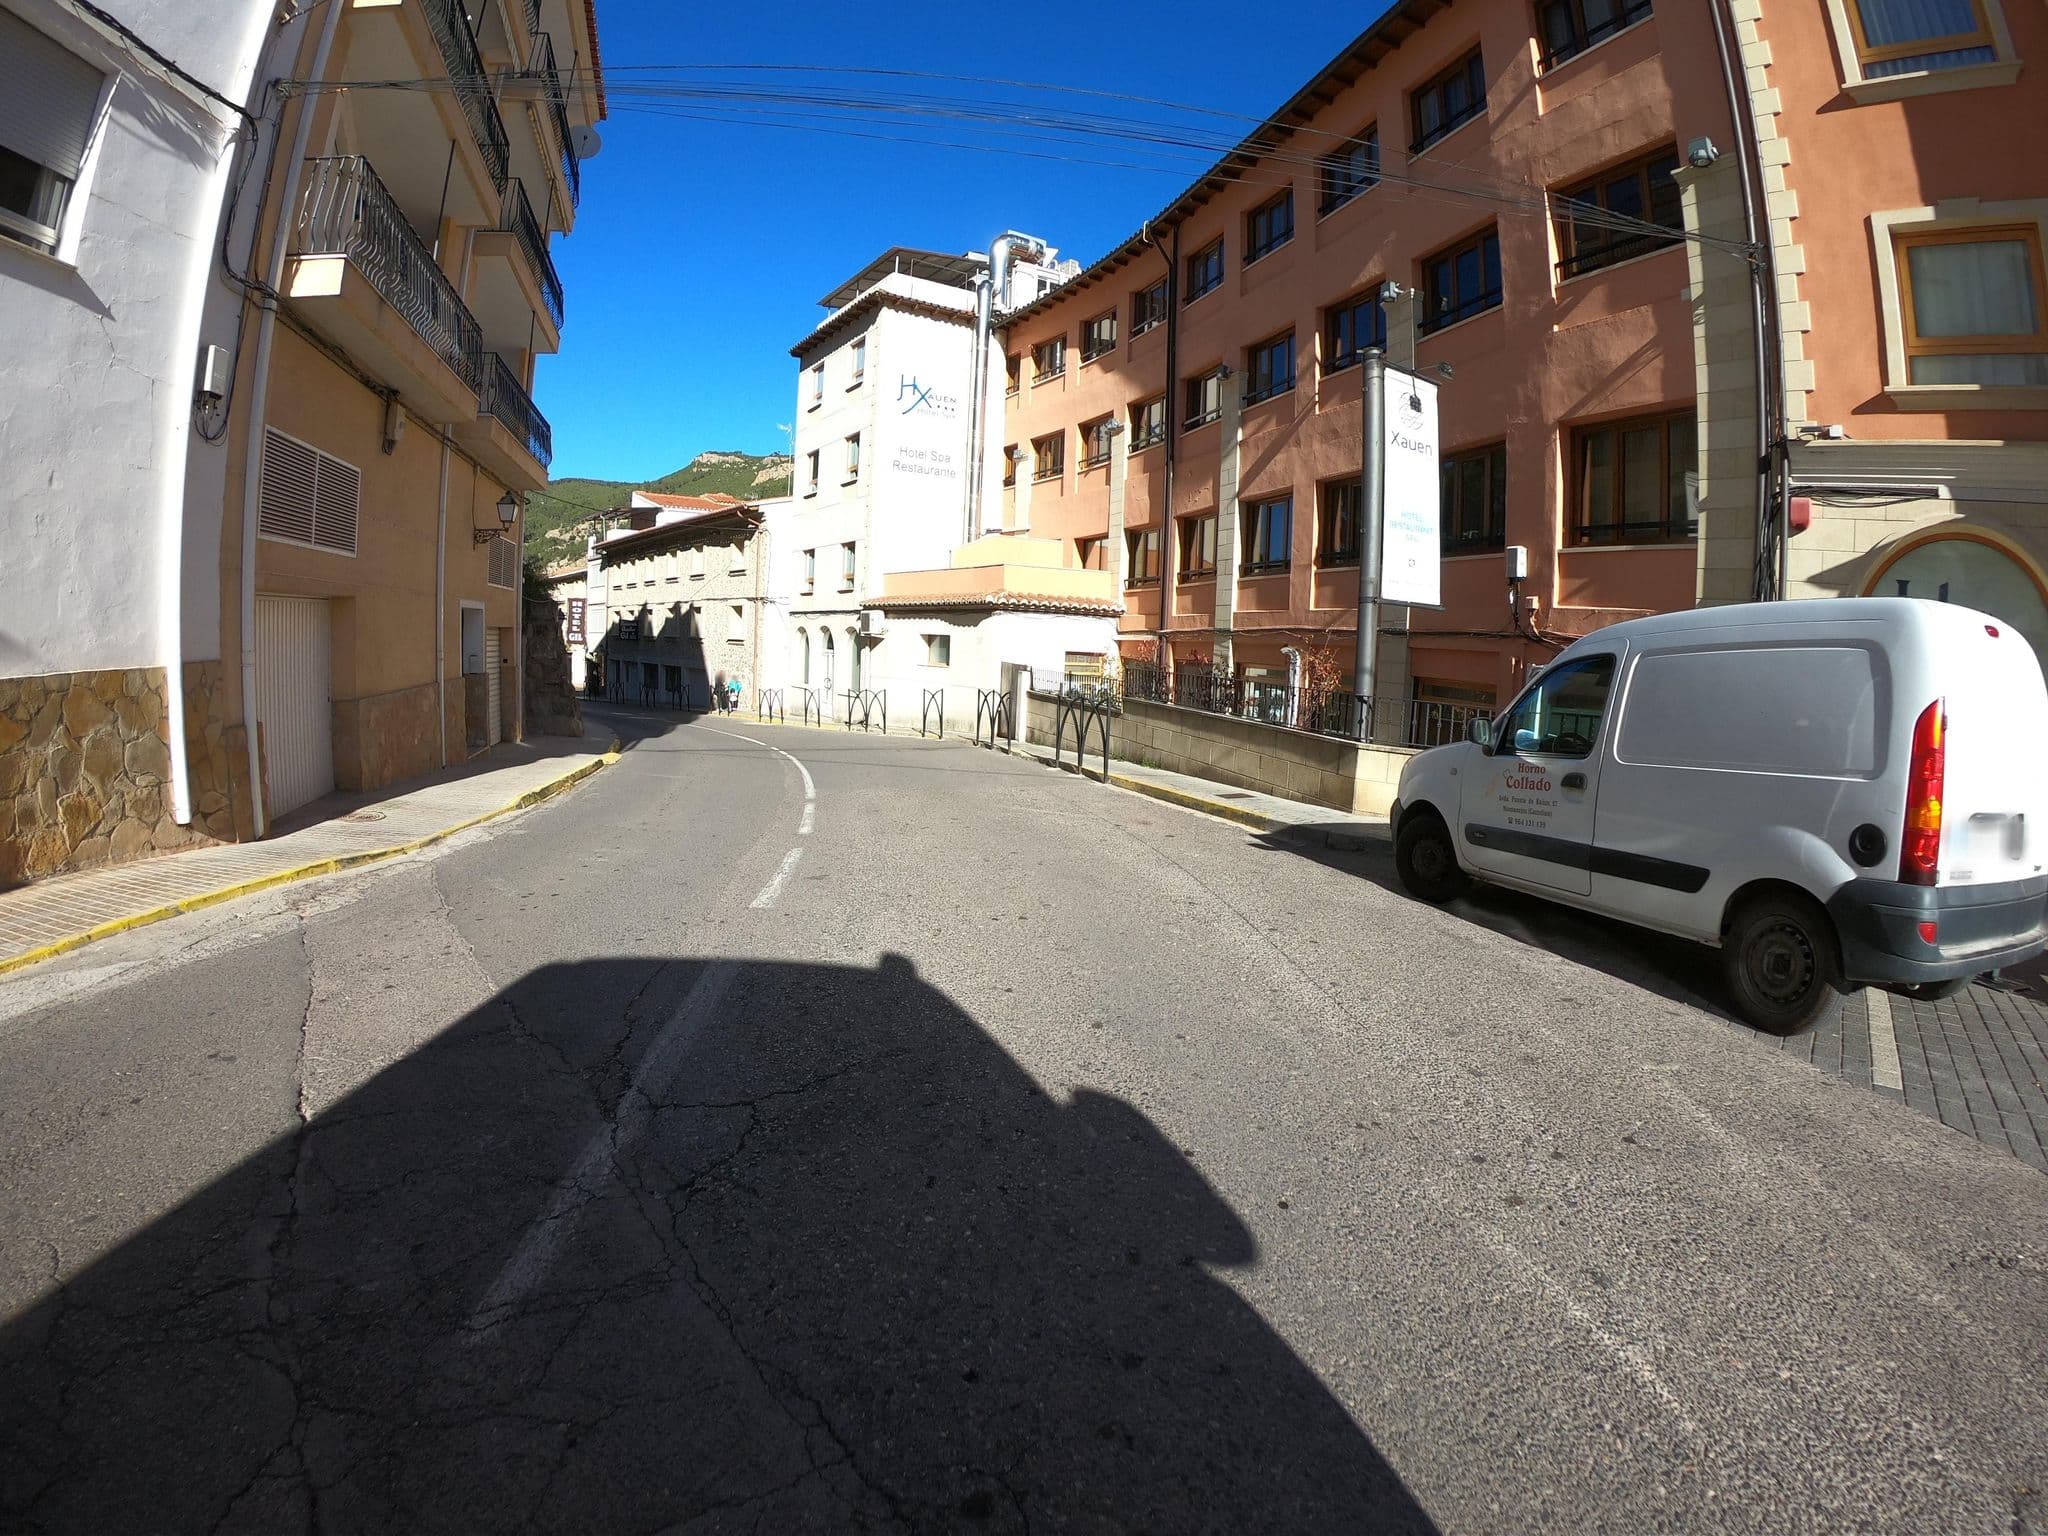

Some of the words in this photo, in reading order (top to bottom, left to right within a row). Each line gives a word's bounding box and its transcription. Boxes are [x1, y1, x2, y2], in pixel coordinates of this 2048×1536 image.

[1391, 430, 1433, 457] Xauen
[899, 446, 928, 461] Hotel
[930, 450, 951, 464] Spa
[892, 459, 957, 479] Restaurante
[571, 600, 583, 632] HOTEL
[569, 632, 584, 641] GIL
[1518, 762, 1546, 775] Horno
[1506, 775, 1552, 792] Collado
